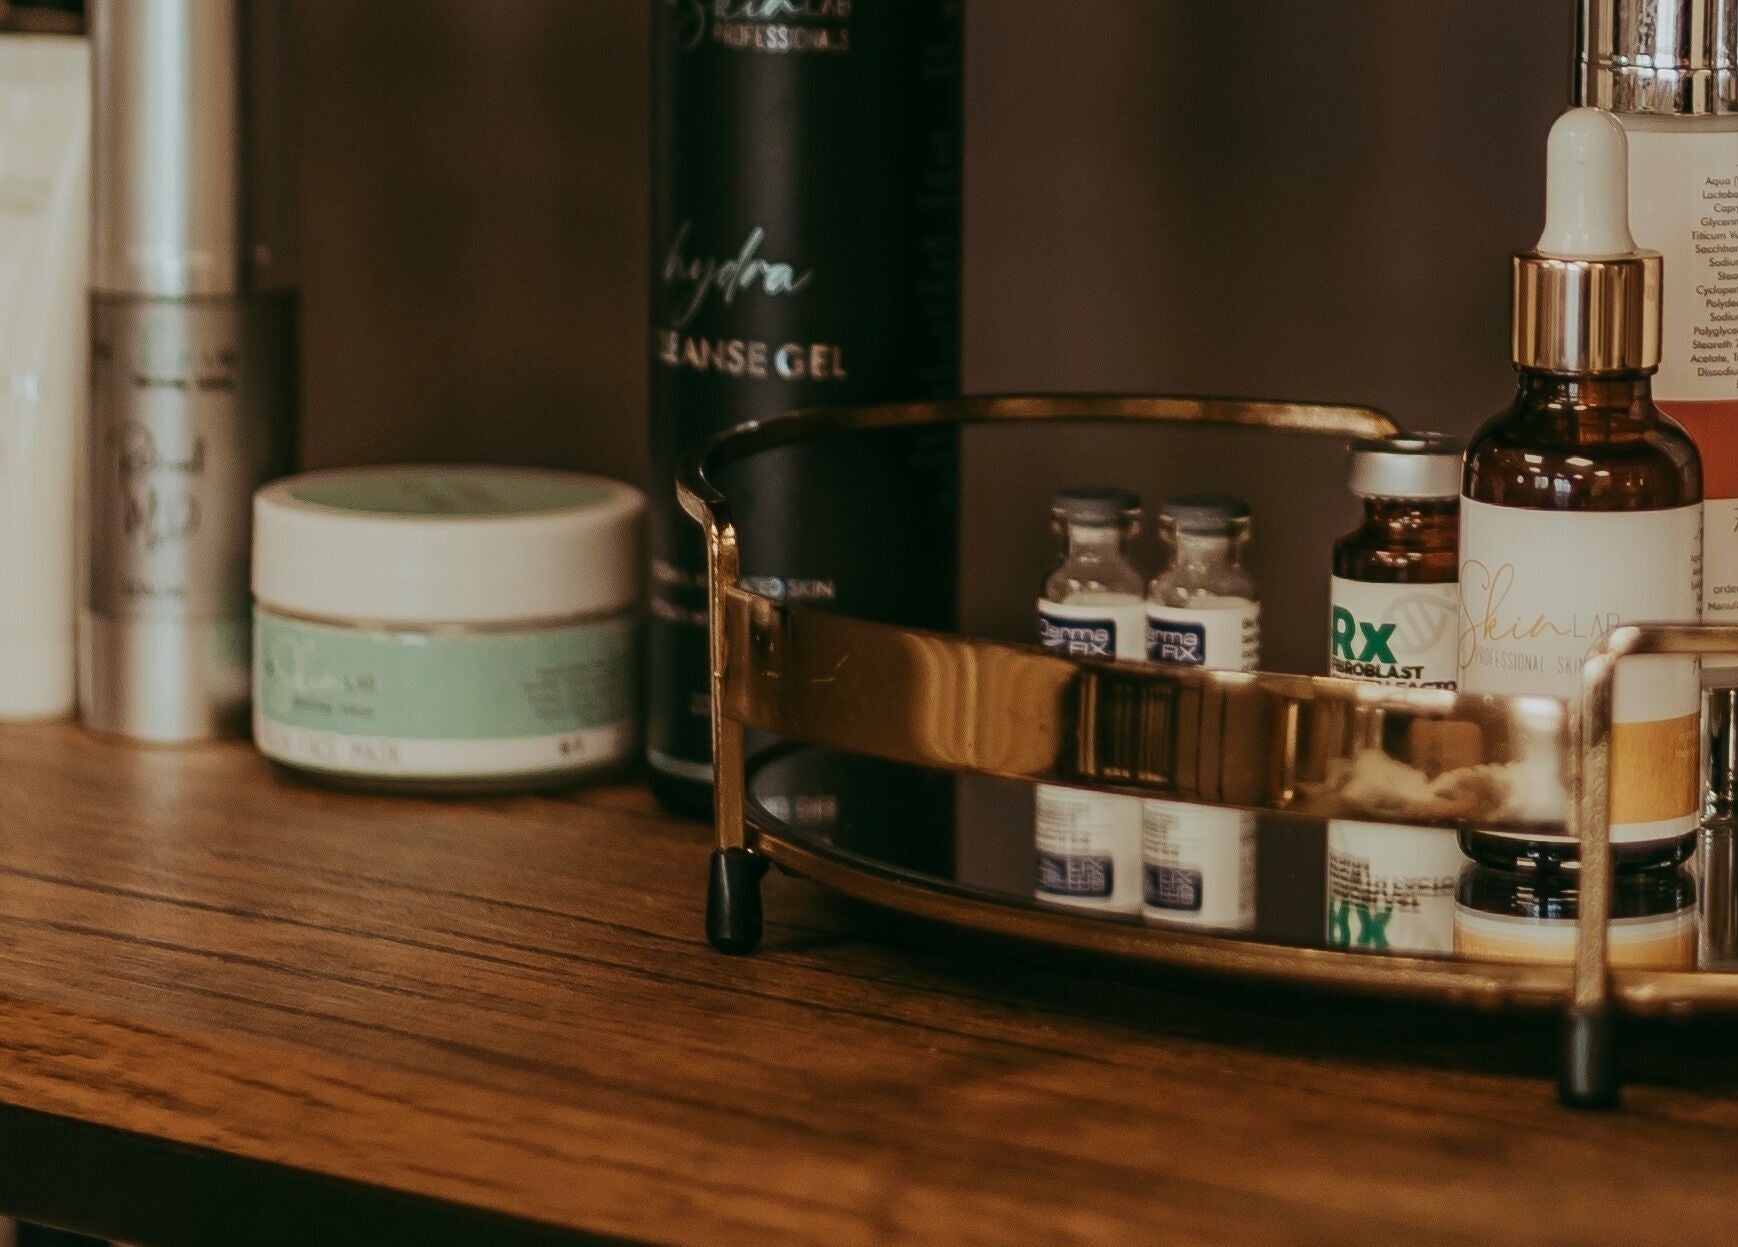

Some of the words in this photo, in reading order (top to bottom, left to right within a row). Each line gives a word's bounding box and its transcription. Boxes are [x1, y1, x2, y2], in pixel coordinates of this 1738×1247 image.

[1705, 176, 1731, 187] Aqua
[1692, 340, 1732, 350] Steareth
[774, 342, 847, 381] GEL
[1690, 354, 1729, 364] Acetate,
[1332, 604, 1398, 664] Rx
